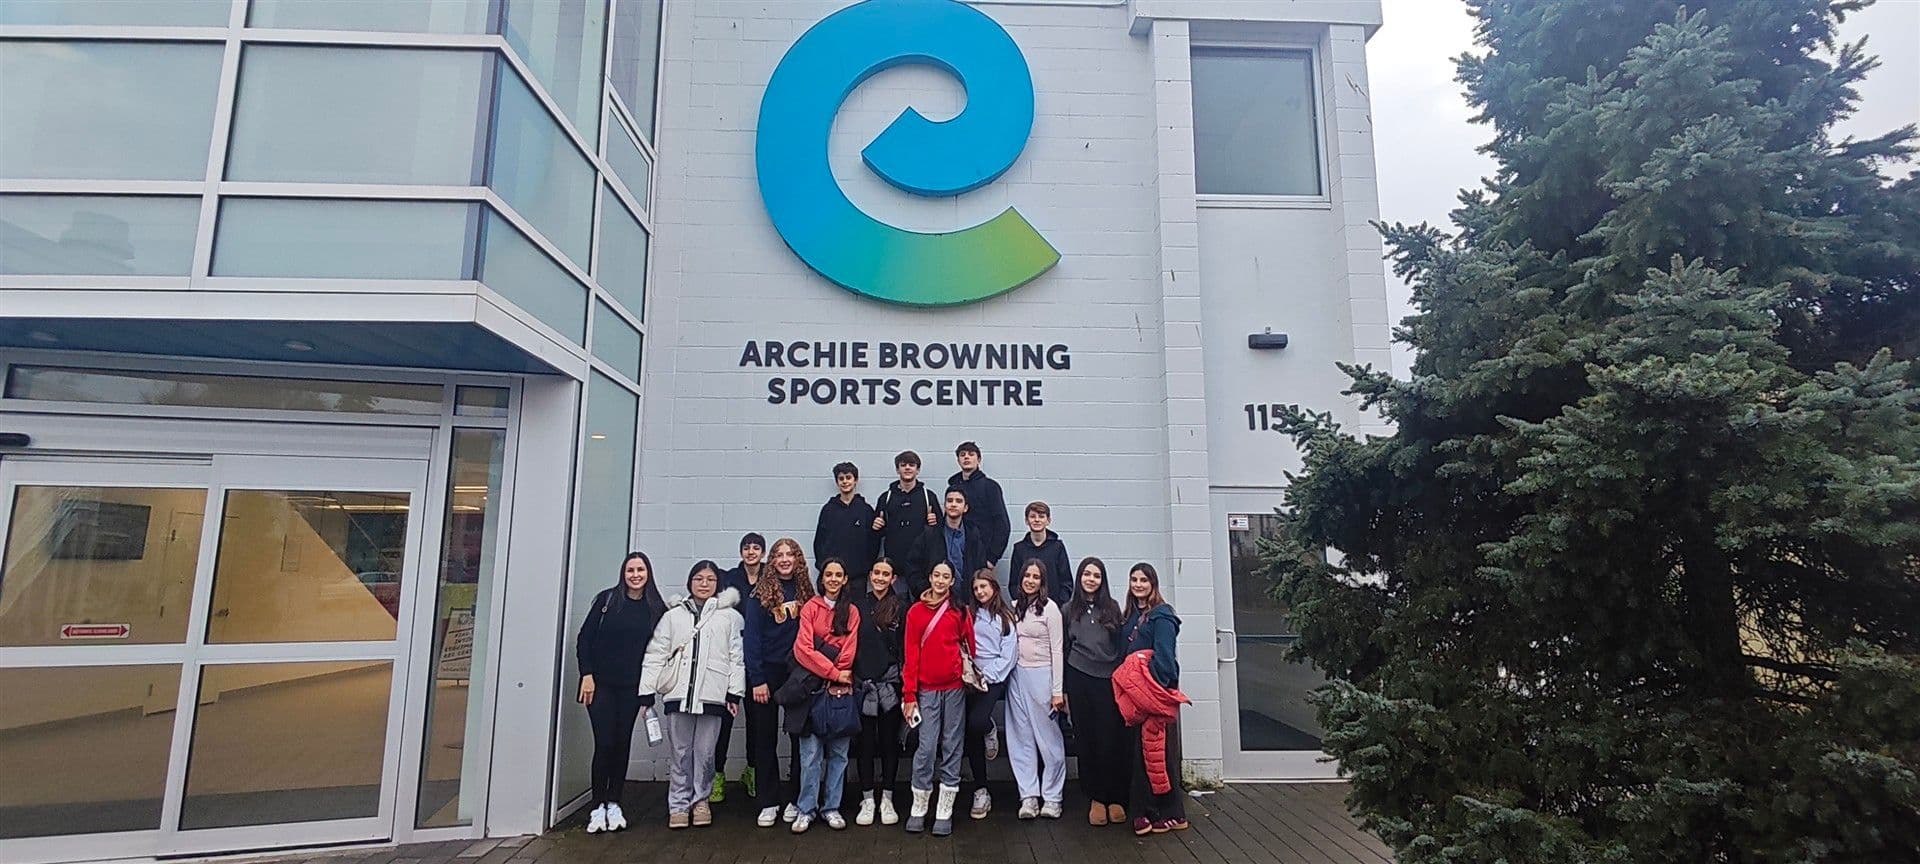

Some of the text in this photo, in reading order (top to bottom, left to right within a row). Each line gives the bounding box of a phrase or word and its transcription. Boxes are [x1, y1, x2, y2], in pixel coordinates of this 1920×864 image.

[739, 340, 1072, 371] ARCHIE BROWNING
[767, 377, 1044, 407] SPORTS CENTRE
